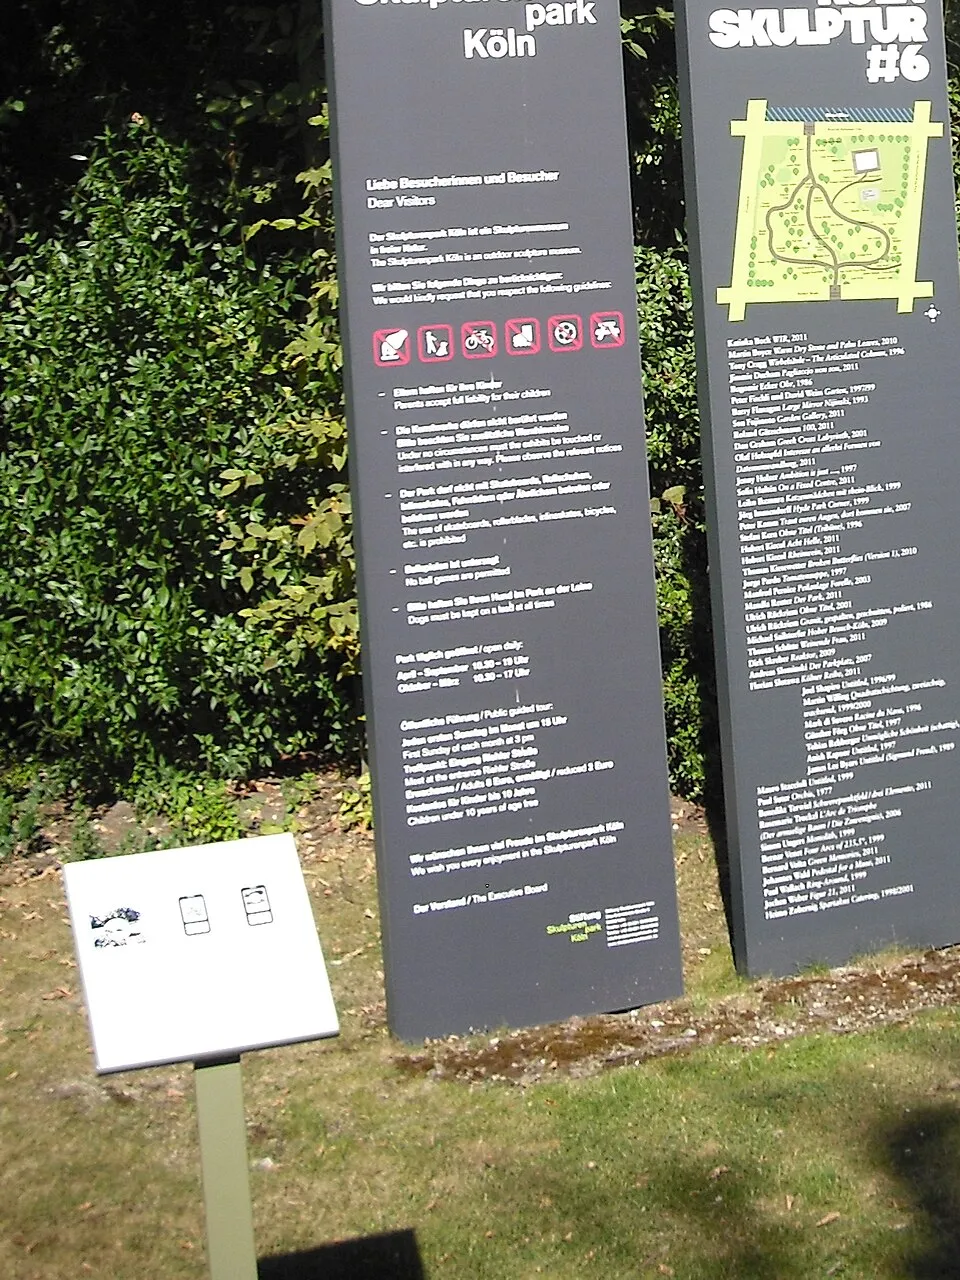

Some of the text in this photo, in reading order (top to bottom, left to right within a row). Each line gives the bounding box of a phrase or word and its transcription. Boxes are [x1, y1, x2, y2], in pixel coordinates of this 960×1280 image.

[708, 5, 929, 48] SKULPTUR
[464, 28, 537, 58] Köln
[865, 44, 930, 83] #6
[506, 170, 559, 183] Besucher
[395, 195, 436, 206] Visitors
